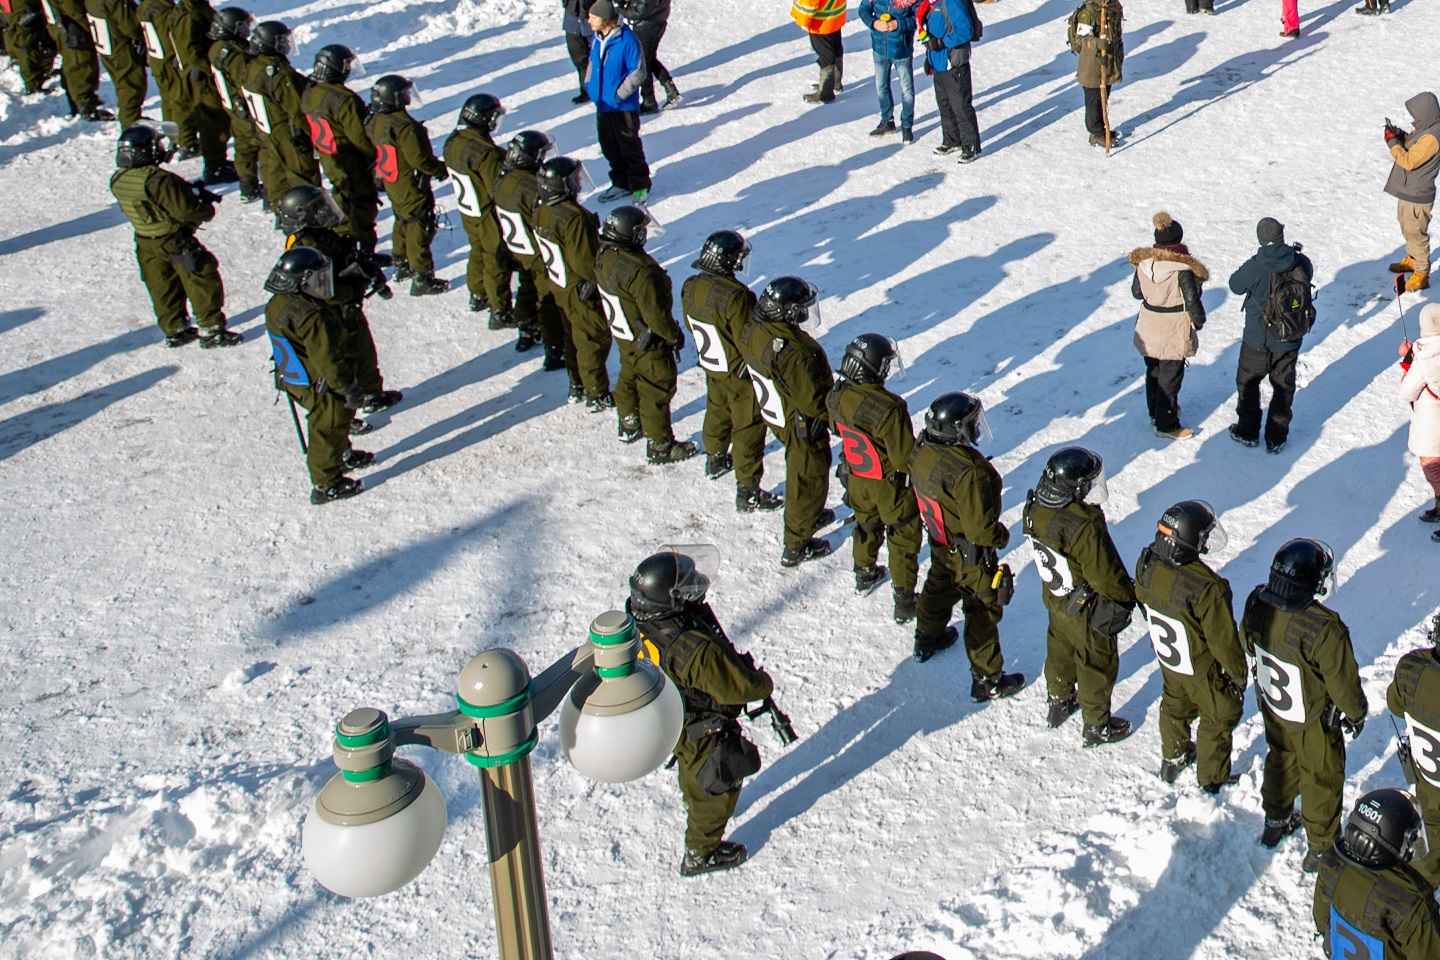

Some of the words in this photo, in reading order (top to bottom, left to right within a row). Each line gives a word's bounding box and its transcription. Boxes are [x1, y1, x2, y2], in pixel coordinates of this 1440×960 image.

[499, 212, 526, 250] 2
[692, 324, 719, 365] 2
[842, 429, 873, 473] 3
[1033, 541, 1063, 591] 3
[1149, 616, 1181, 667] 3
[1261, 654, 1292, 711] 3
[1357, 803, 1383, 824] 10601
